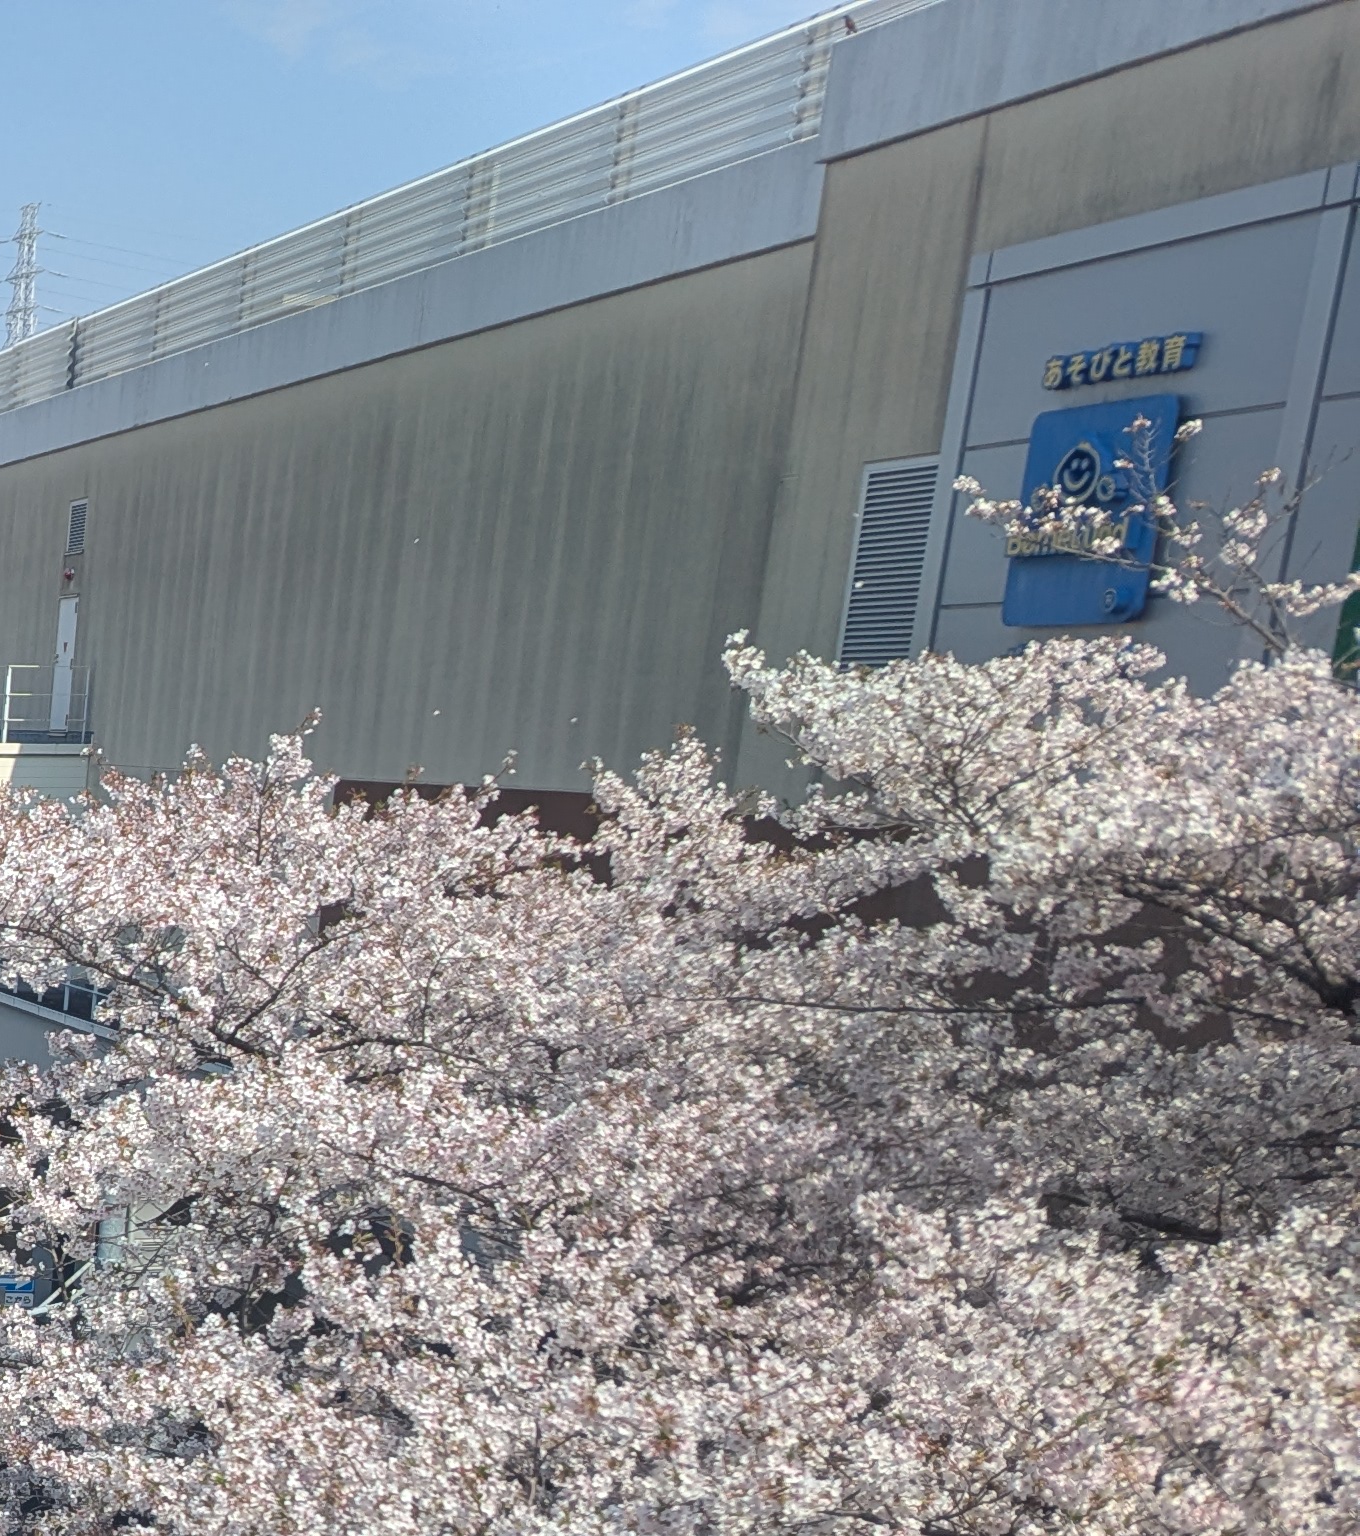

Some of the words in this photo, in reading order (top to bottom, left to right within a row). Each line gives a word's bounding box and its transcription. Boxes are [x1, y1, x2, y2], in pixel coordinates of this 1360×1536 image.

[1043, 334, 1187, 389] あそびと教育
